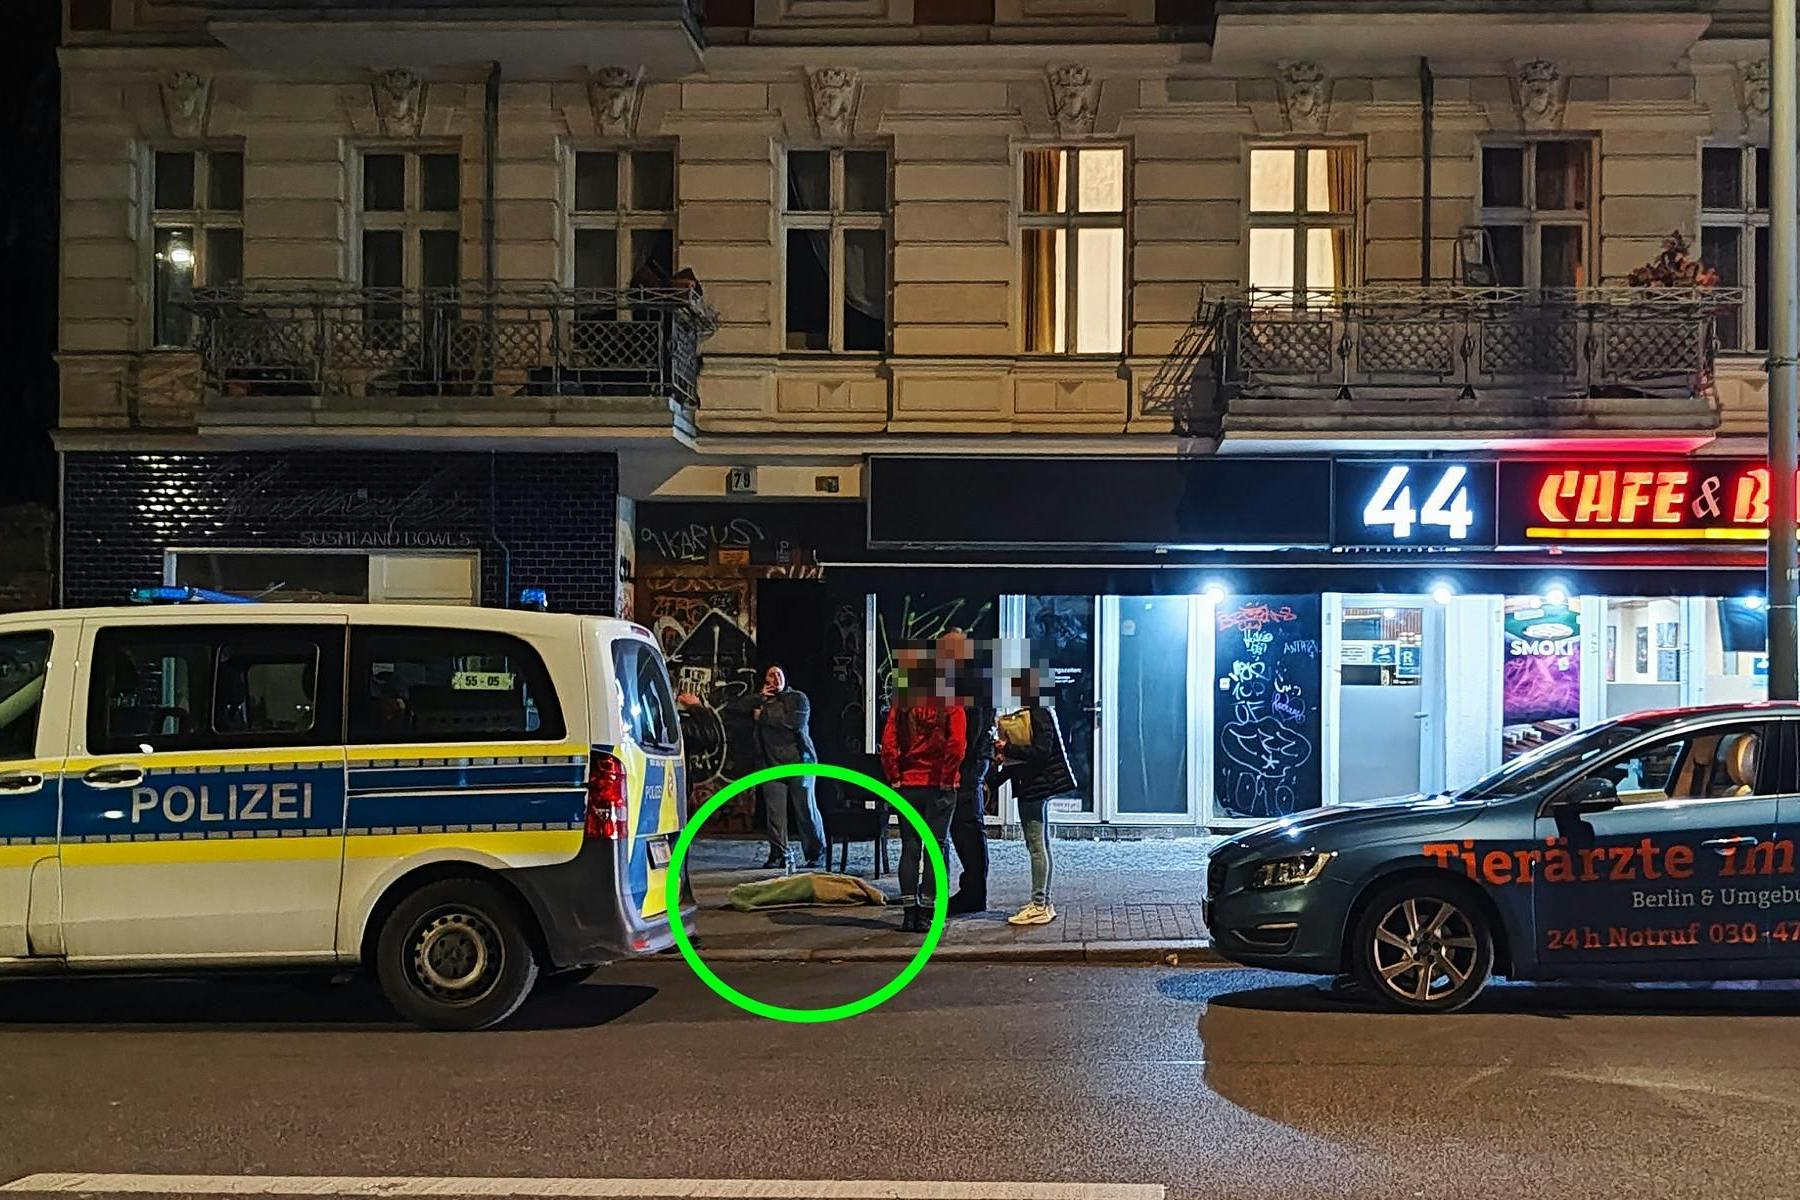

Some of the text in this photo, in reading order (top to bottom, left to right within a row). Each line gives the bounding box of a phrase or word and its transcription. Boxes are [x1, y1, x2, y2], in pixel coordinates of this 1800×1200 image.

[733, 472, 751, 489] 79
[1363, 465, 1473, 539] 44
[1538, 470, 1688, 522] CAFE
[1691, 475, 1721, 519] &
[300, 532, 471, 546] SUSHI AND BOWLS
[465, 676, 478, 687] 55
[487, 676, 500, 687] 05
[131, 783, 312, 824] POLIZEI
[1423, 835, 1795, 886] Tierärzte im
[1632, 889, 1695, 908] Berlin
[1700, 888, 1715, 906] &
[1608, 922, 1700, 947] Notruf
